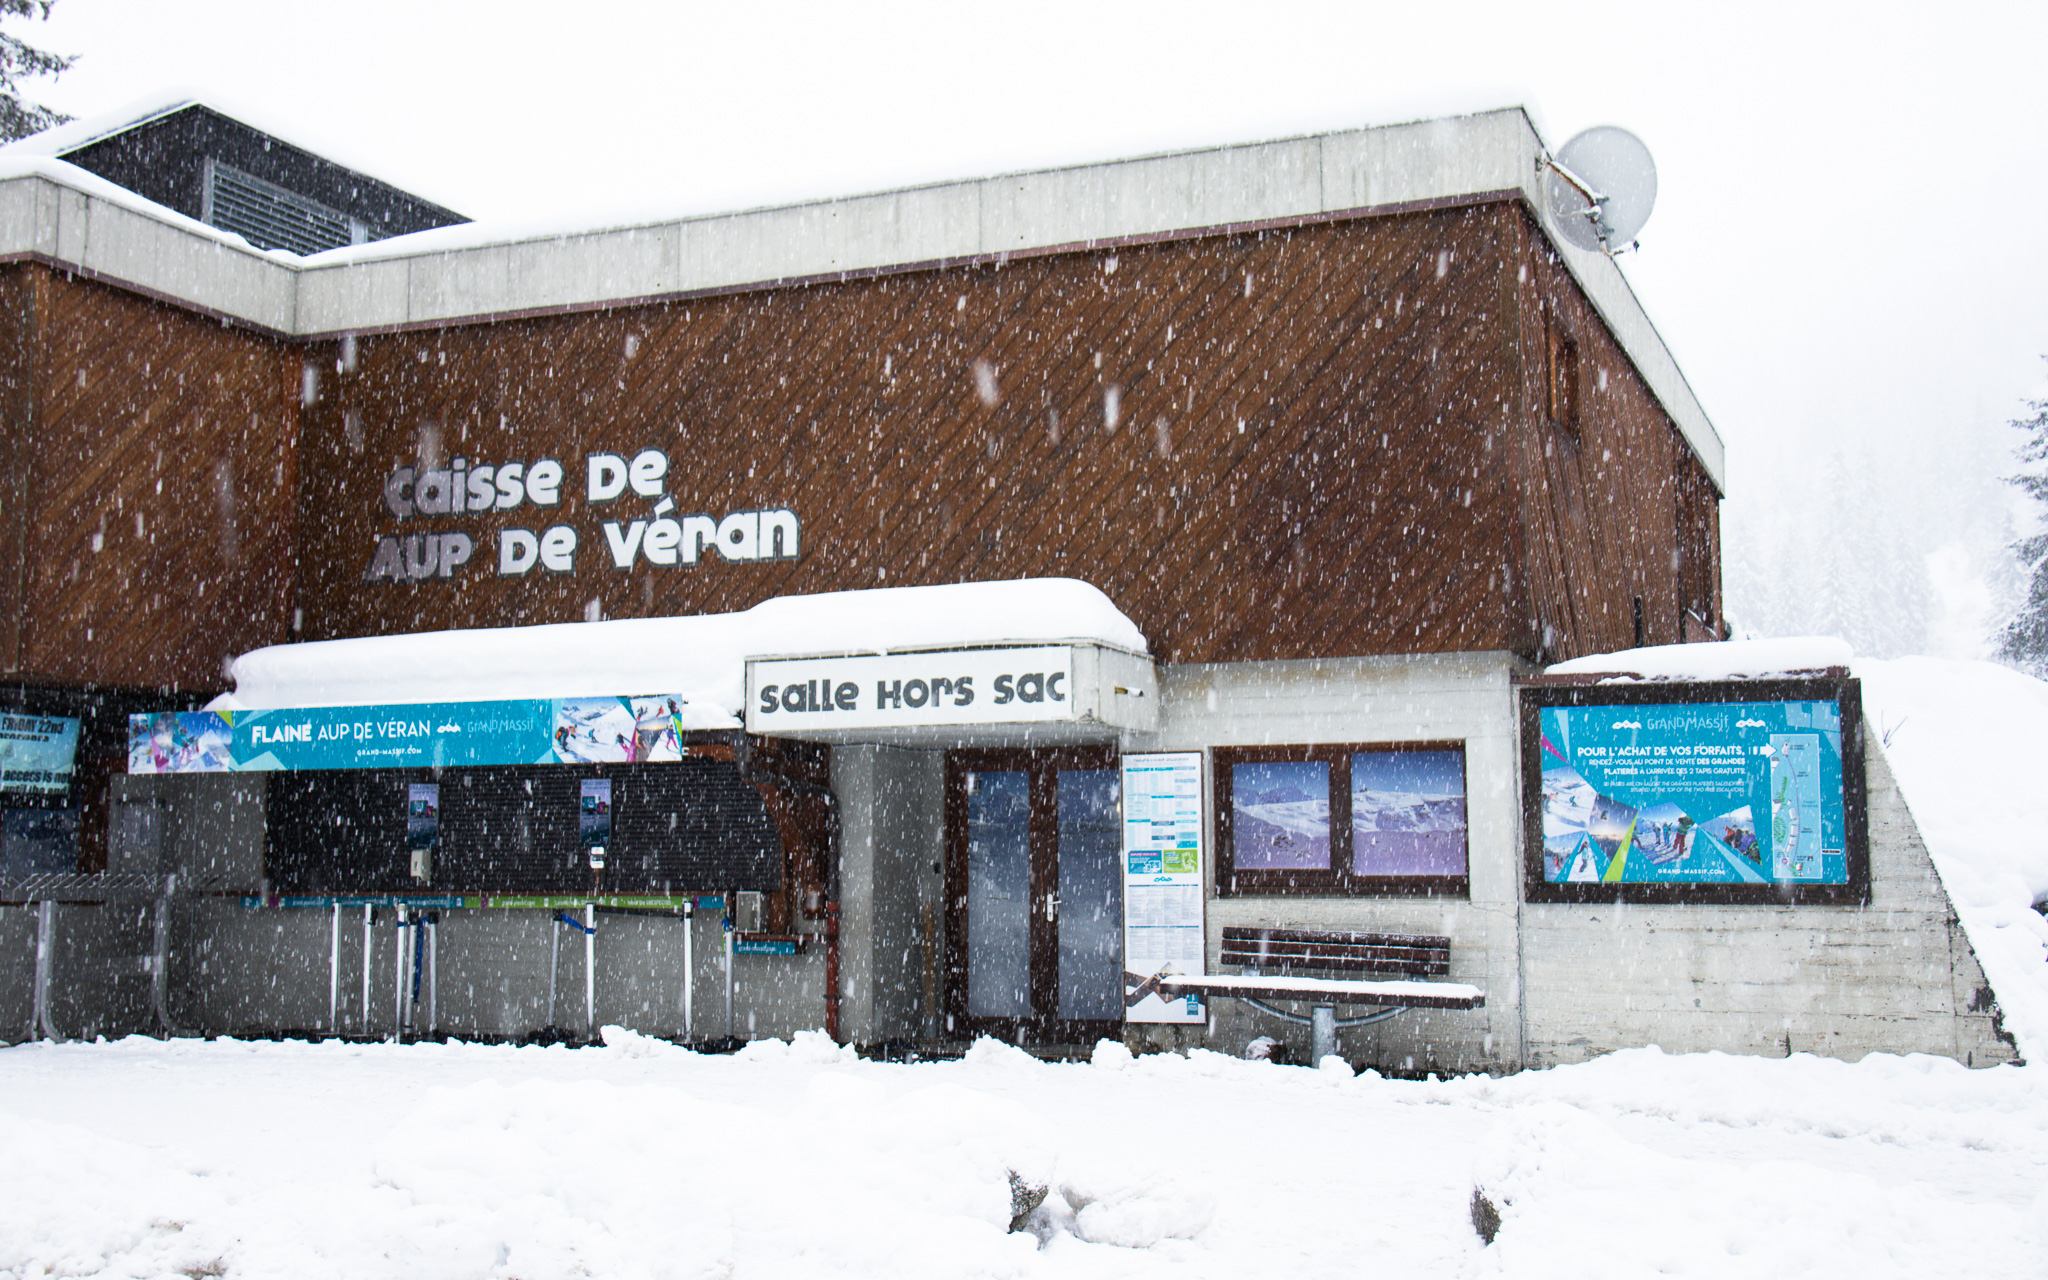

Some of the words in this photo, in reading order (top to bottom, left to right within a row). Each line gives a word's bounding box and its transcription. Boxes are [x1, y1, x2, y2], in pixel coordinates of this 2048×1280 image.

[364, 532, 473, 583] AUP
[1, 716, 38, 732] FRIDAY
[38, 719, 66, 735] 22nd
[251, 724, 313, 743] FLAINE
[317, 722, 350, 741] AUP
[354, 722, 373, 740] DE
[378, 717, 431, 738] VÉRAN
[356, 748, 422, 756] GRAND-MASSIF.COM
[1577, 747, 1607, 757] POUR
[1609, 746, 1651, 756] L'ACHAT
[1654, 746, 1668, 756] DE
[1670, 746, 1692, 756] VOS
[3, 769, 41, 782] access
[42, 769, 53, 783] is
[54, 771, 73, 784] not
[29, 784, 46, 794] the
